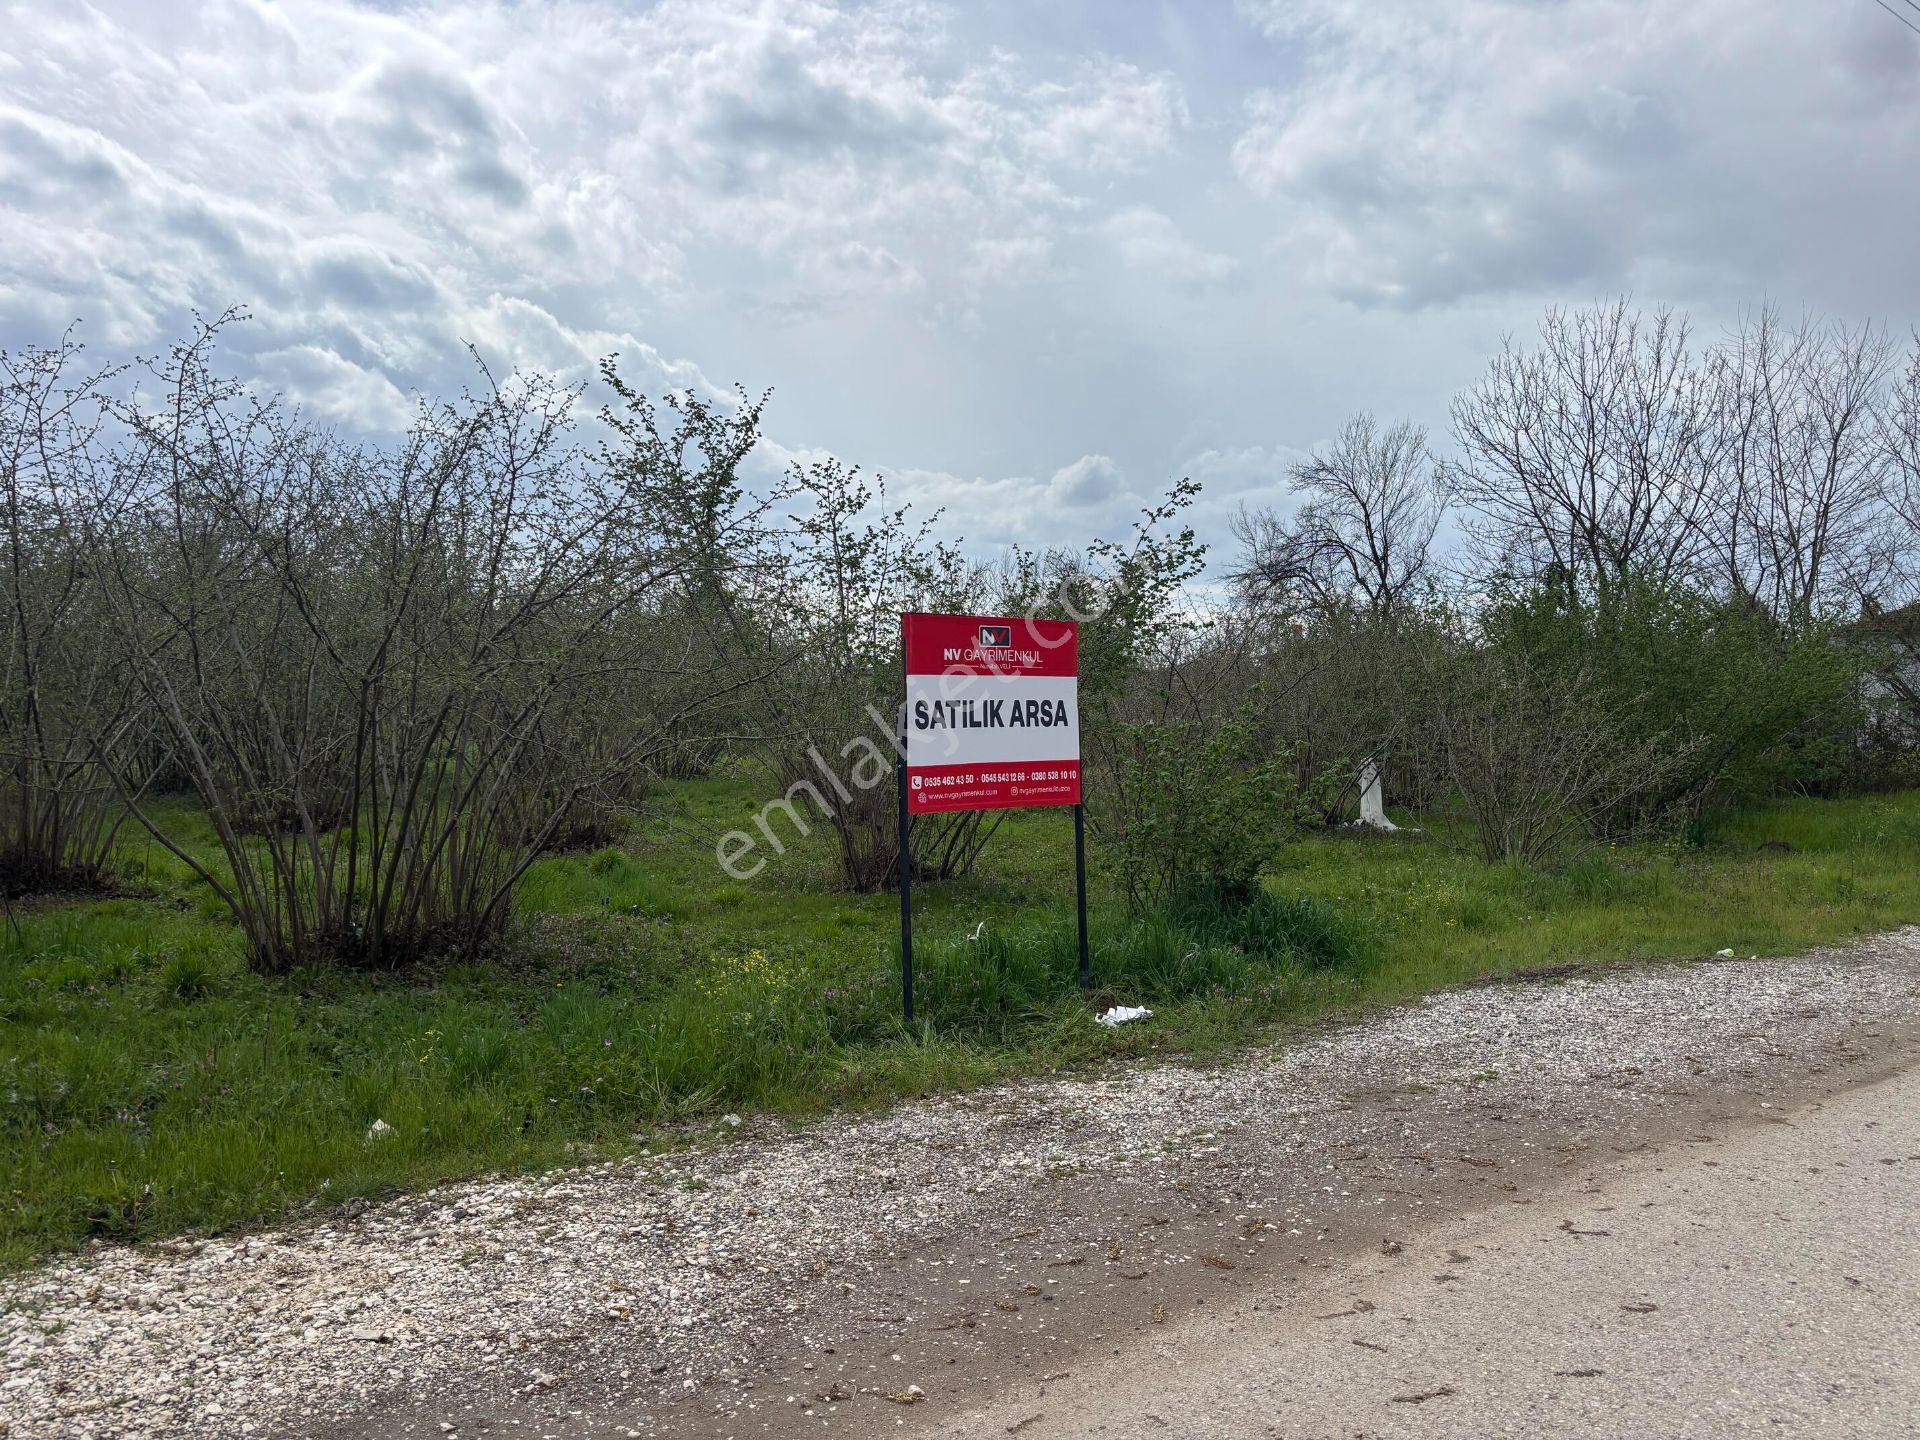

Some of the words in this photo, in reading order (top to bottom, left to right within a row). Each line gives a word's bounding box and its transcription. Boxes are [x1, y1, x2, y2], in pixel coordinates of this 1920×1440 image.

[981, 628, 1008, 645] NV
[943, 648, 962, 661] NV
[915, 699, 1005, 730] SATILIK
[1009, 699, 1069, 728] ARSA
[924, 777, 941, 787] 0535
[942, 776, 955, 786] 462
[956, 775, 964, 785] 43
[965, 774, 974, 784] 50
[981, 773, 997, 783] 0545
[997, 773, 1010, 782] 543
[1010, 772, 1017, 782] 12
[1017, 772, 1025, 781] 66
[1031, 771, 1047, 781] 0380
[1047, 770, 1059, 780] 538
[1060, 770, 1068, 780] 10
[1069, 770, 1077, 779] 10
